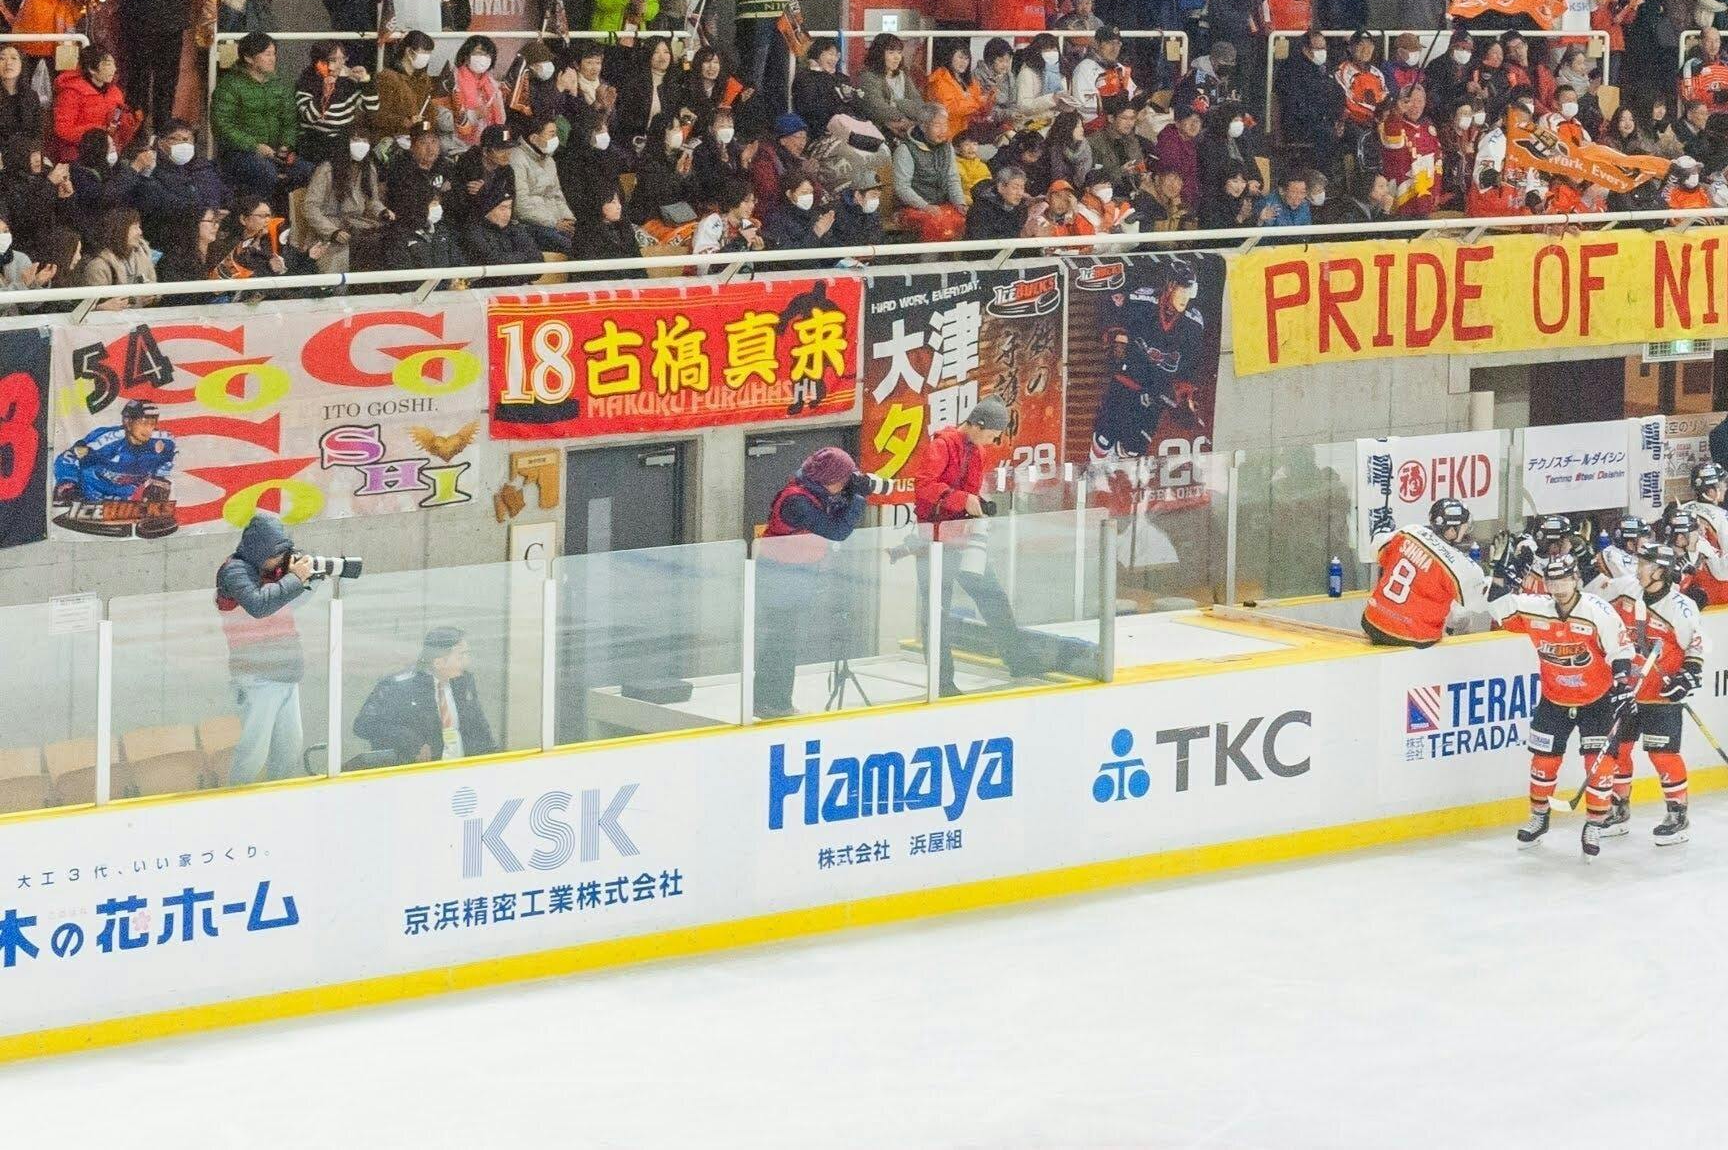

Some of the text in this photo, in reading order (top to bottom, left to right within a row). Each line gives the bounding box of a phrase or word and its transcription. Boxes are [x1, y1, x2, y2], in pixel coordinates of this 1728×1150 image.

[1264, 245, 1494, 365] PRIDE
[1531, 242, 1619, 336] OF
[73, 323, 175, 415] 54
[301, 311, 482, 395] Go
[496, 318, 576, 406] 18
[872, 300, 982, 405] 大津
[323, 404, 362, 421] ITO
[1430, 453, 1492, 501] FKD
[1528, 451, 1626, 471] テクノスチールダイシン
[892, 503, 911, 526] D
[525, 542, 546, 572] C
[1382, 557, 1417, 605] 8
[768, 735, 1014, 830] Hamaya
[1155, 709, 1312, 793] TKC
[817, 827, 963, 870] 株式会社 浜屋組
[0, 880, 300, 968] 木の花ホーム
[403, 867, 684, 937] 京浜精密工業株式会社
